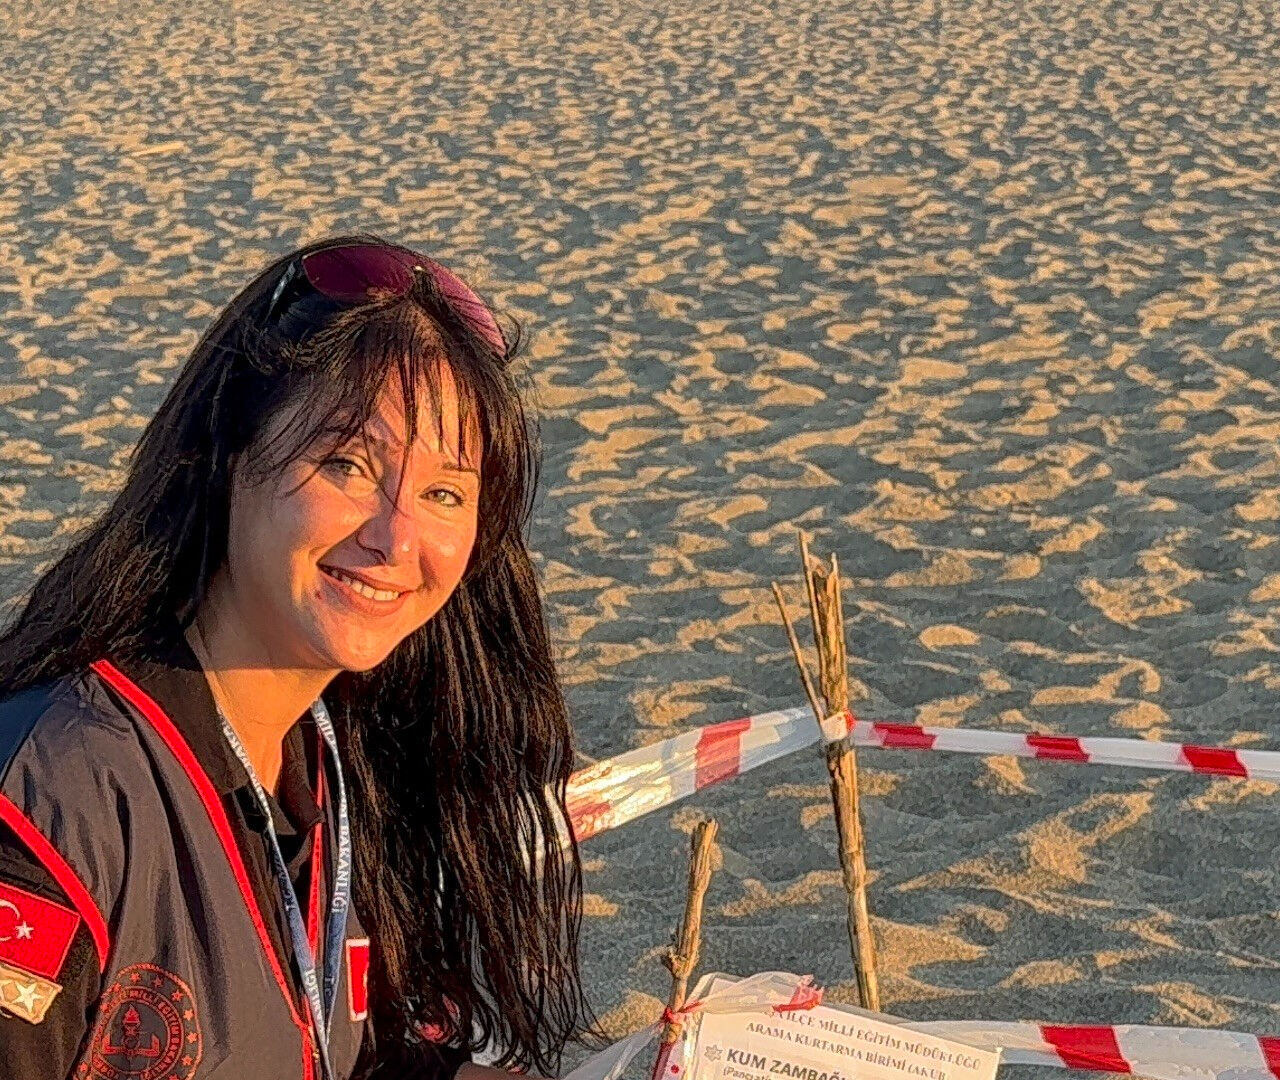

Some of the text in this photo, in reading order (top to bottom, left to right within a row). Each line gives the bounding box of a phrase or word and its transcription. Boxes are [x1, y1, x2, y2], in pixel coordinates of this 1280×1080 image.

[746, 1022, 792, 1042] ARAMA
[794, 1033, 863, 1060] KURTARMA
[865, 1051, 906, 1071] BİRİMİ
[819, 1019, 855, 1037] MİLLİ
[856, 1028, 901, 1050] EĞİTİM
[726, 1048, 767, 1071] KUM
